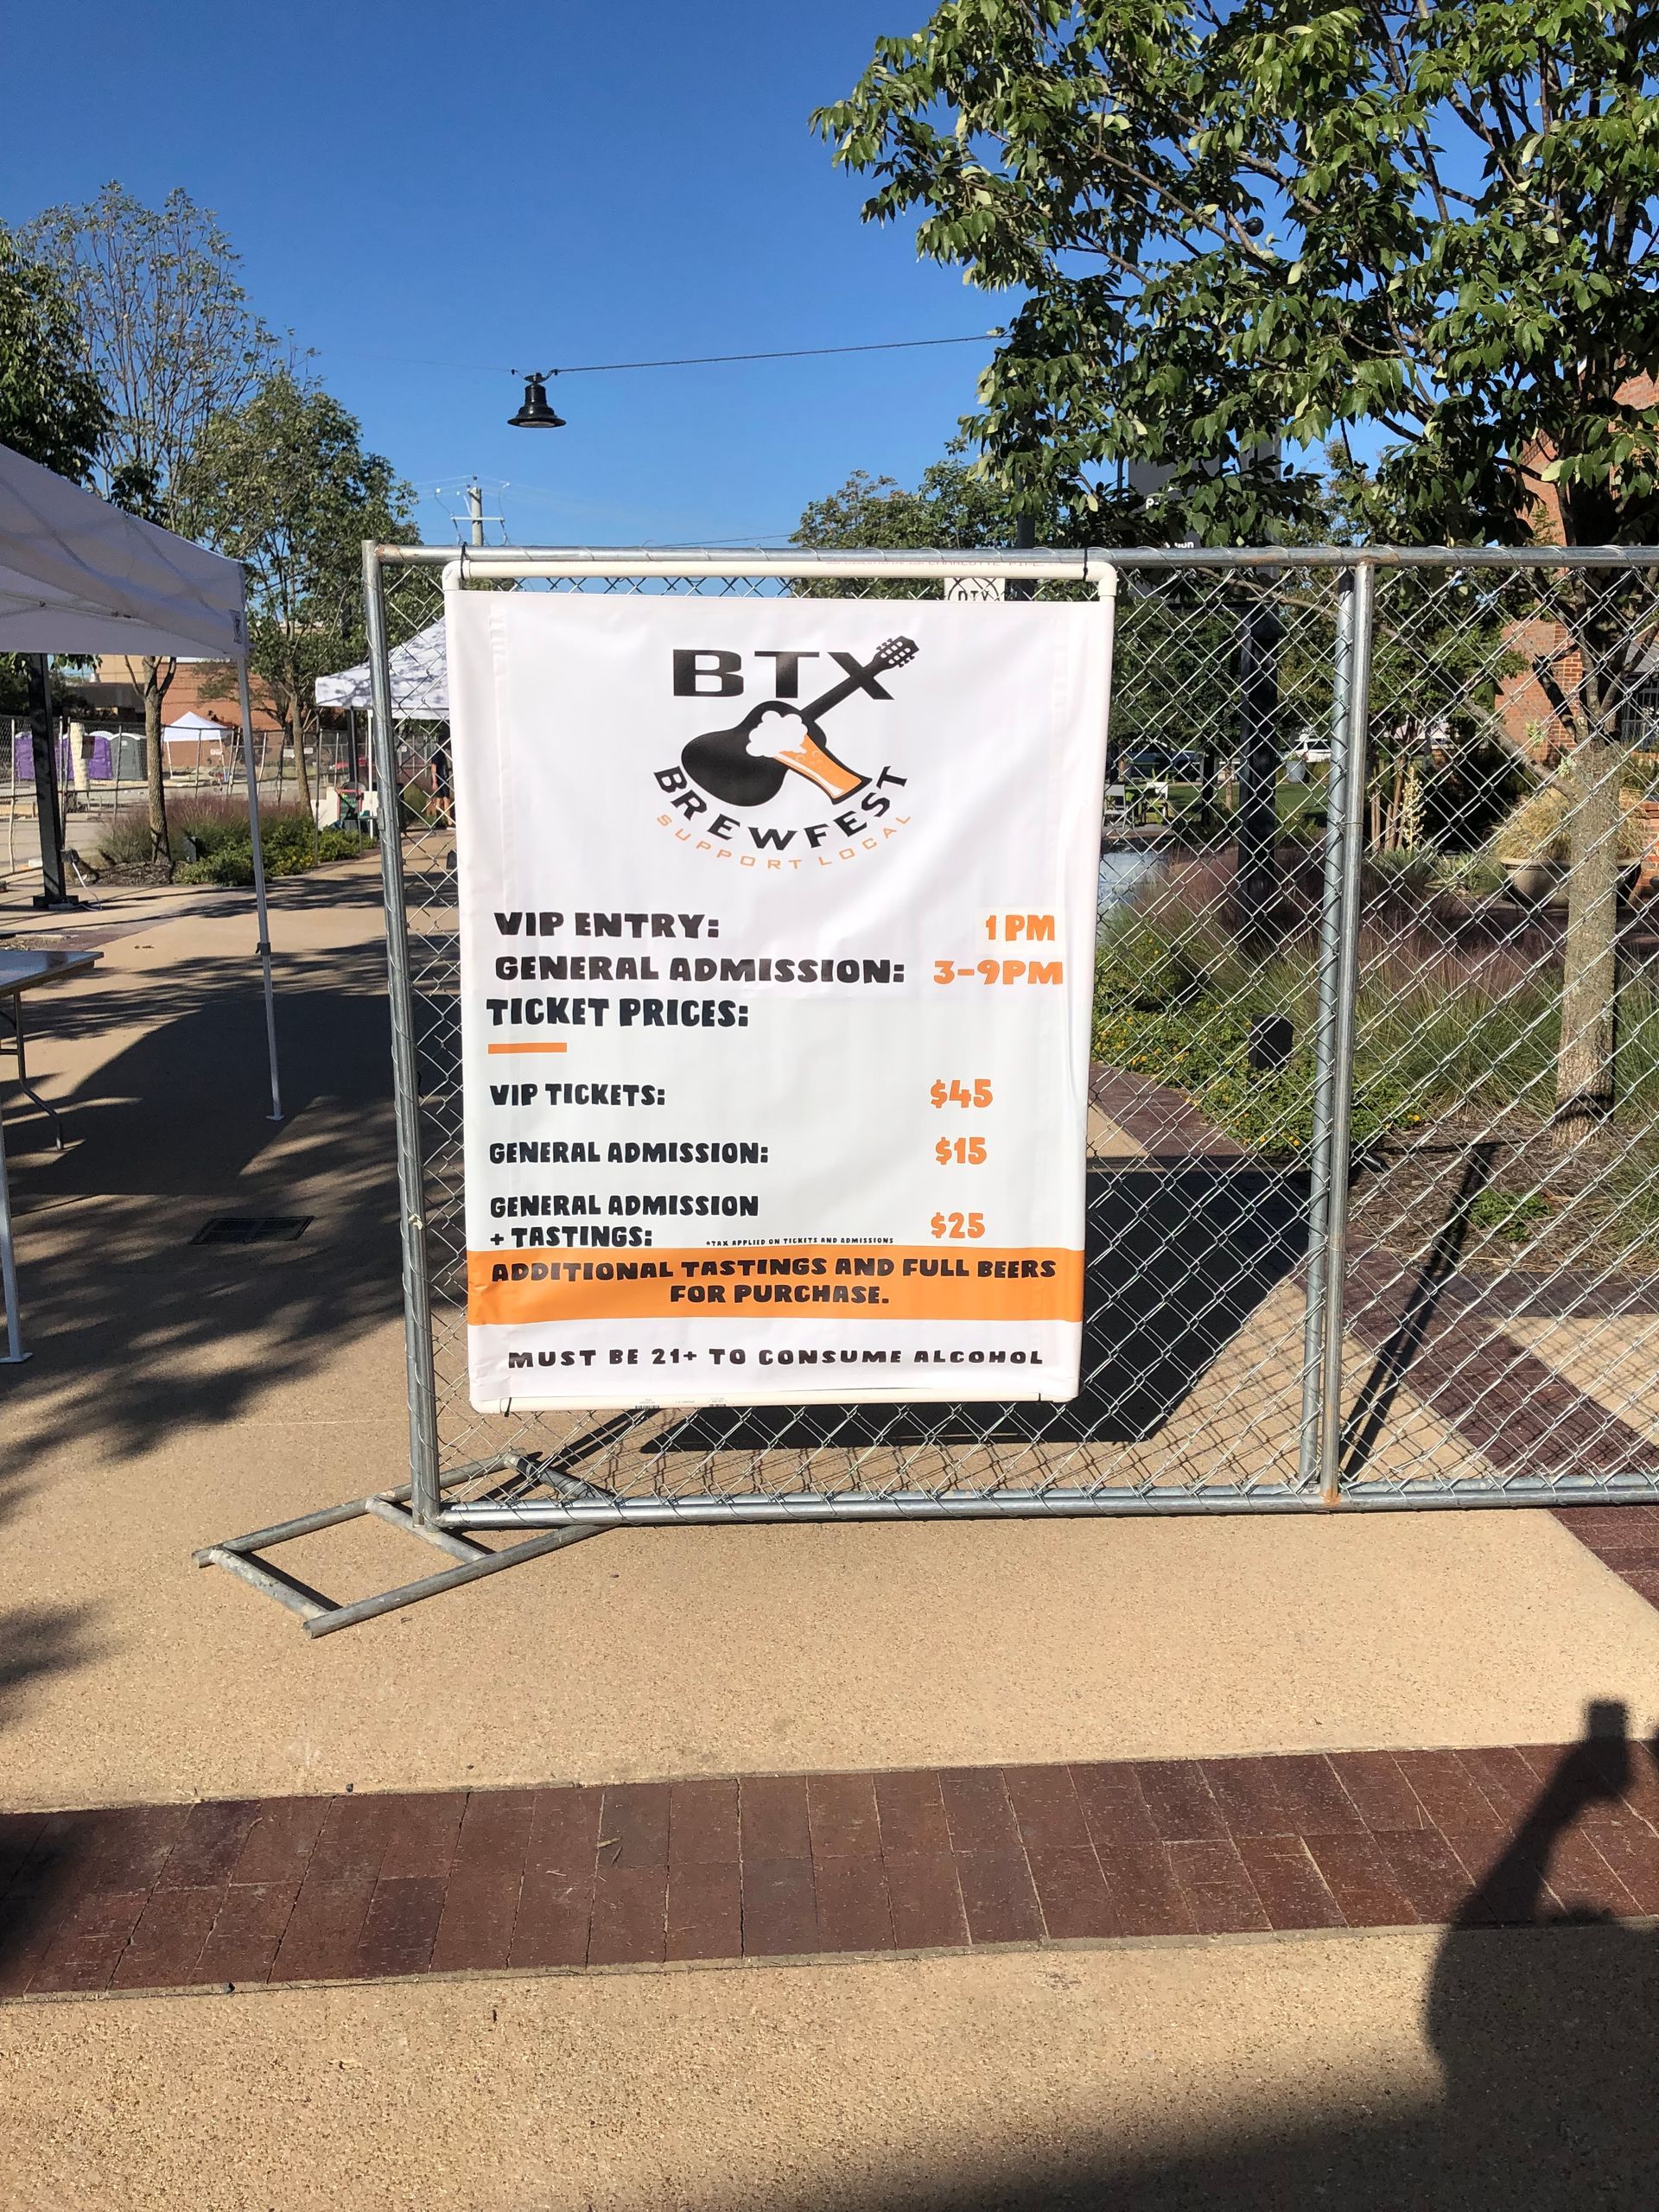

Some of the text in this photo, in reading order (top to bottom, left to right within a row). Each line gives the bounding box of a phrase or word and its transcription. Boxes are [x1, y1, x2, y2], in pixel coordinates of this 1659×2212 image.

[673, 650, 895, 701] BTX
[653, 766, 908, 850] BREWFEST
[657, 814, 911, 869] SUPPORT LOCAL
[494, 912, 719, 939] VIP ENTRY:
[986, 914, 1055, 942] 1 PM
[495, 956, 906, 984] GENERAL ADMISSION:
[933, 959, 1064, 985] 3-9PM
[486, 997, 748, 1027] TICKET PRICES:
[490, 1084, 665, 1107] VIP TICKETS:
[930, 1078, 994, 1109] $45
[489, 1141, 768, 1165] GENERAL ADMISSION:
[935, 1136, 987, 1166] $15
[490, 1194, 759, 1218] GENERAL ADMISSION
[490, 1225, 652, 1249] + TASTINGS:
[931, 1211, 986, 1239] $25
[492, 1258, 1057, 1282] ADDITIONAL TASTINGS AND FULL BEERS
[671, 1285, 890, 1305] FOR PURCHASE.
[508, 1348, 1044, 1369] MUST BE 21+ TO CONSUME ALCOHOL
